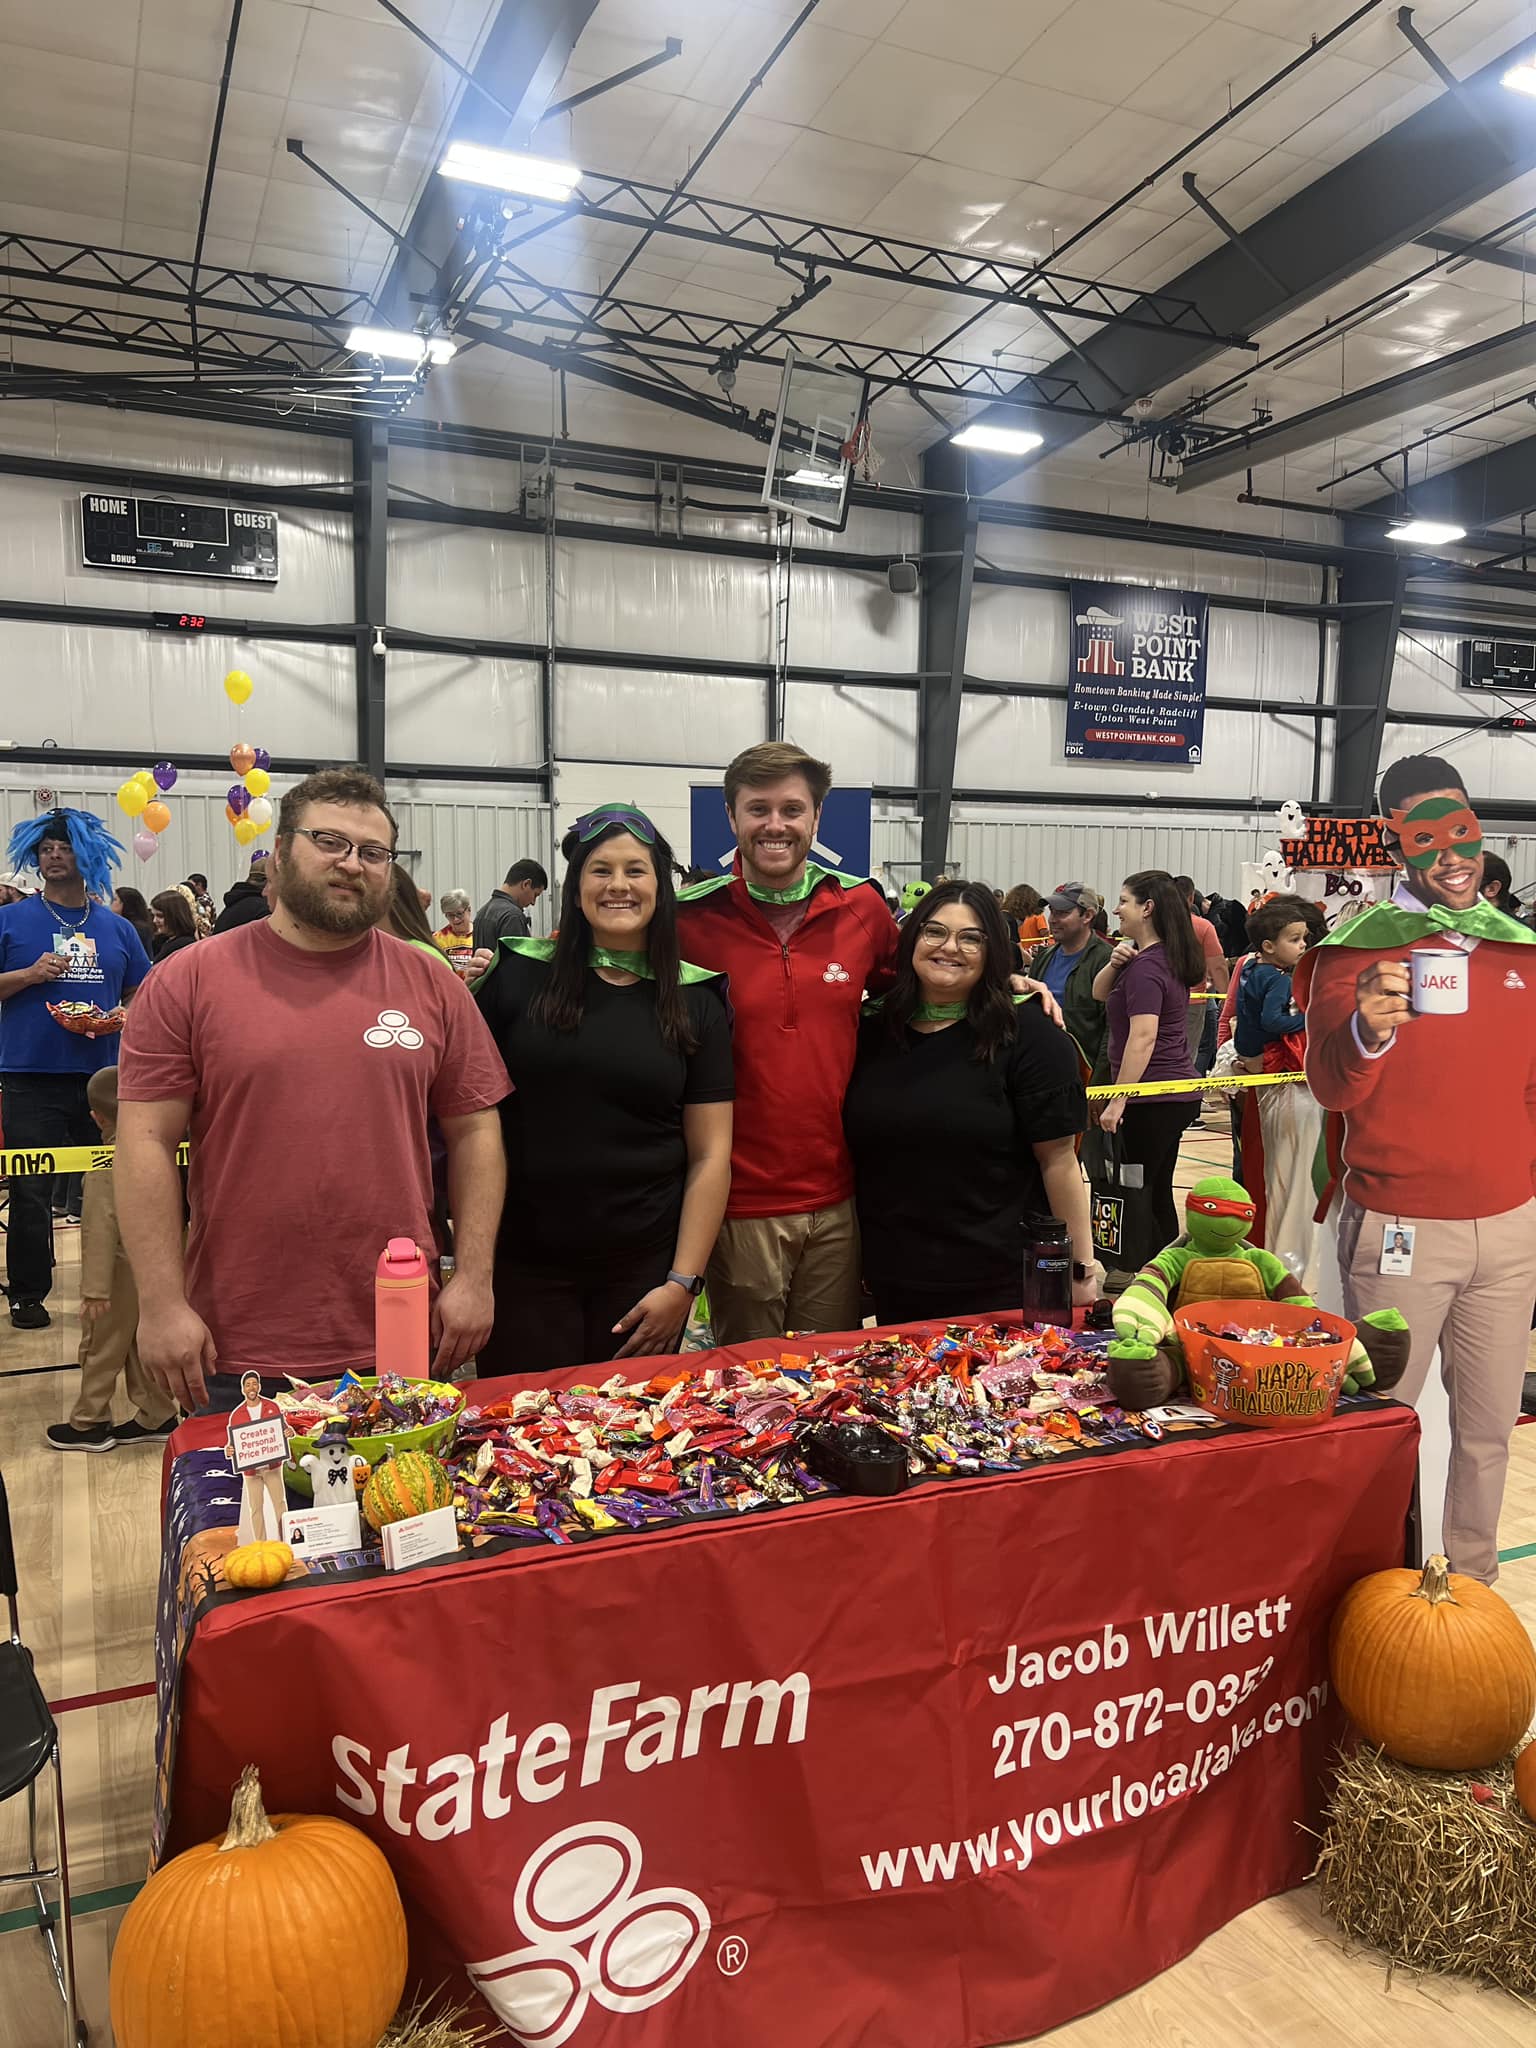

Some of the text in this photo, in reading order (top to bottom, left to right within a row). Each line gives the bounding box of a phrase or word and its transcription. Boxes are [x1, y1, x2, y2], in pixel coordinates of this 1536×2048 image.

[90, 497, 128, 516] HOME
[234, 512, 273, 530] GUEST
[111, 553, 137, 564] BONUS
[179, 615, 206, 628] 2:32
[1132, 612, 1198, 636] WEST
[1131, 634, 1202, 661] POINT
[1131, 657, 1195, 683] BANK
[1074, 683, 1203, 704] Hometown Banking Made Simple!
[1073, 701, 1199, 720] E-town Glendale Radcliff
[1094, 713, 1178, 727] Upton West Point
[1095, 731, 1177, 744] WESTPOINTBANK.COM
[1065, 746, 1084, 755] FDIC
[1308, 819, 1385, 844] HAPPY
[1420, 974, 1458, 990] JAKE
[1256, 1361, 1319, 1392] HAPPY
[1231, 1387, 1328, 1416] HALLOWEEN
[240, 1428, 268, 1441] Create
[241, 1435, 276, 1450] Personal
[239, 1449, 261, 1461] Price
[987, 1594, 1292, 1696] Jacob Willett
